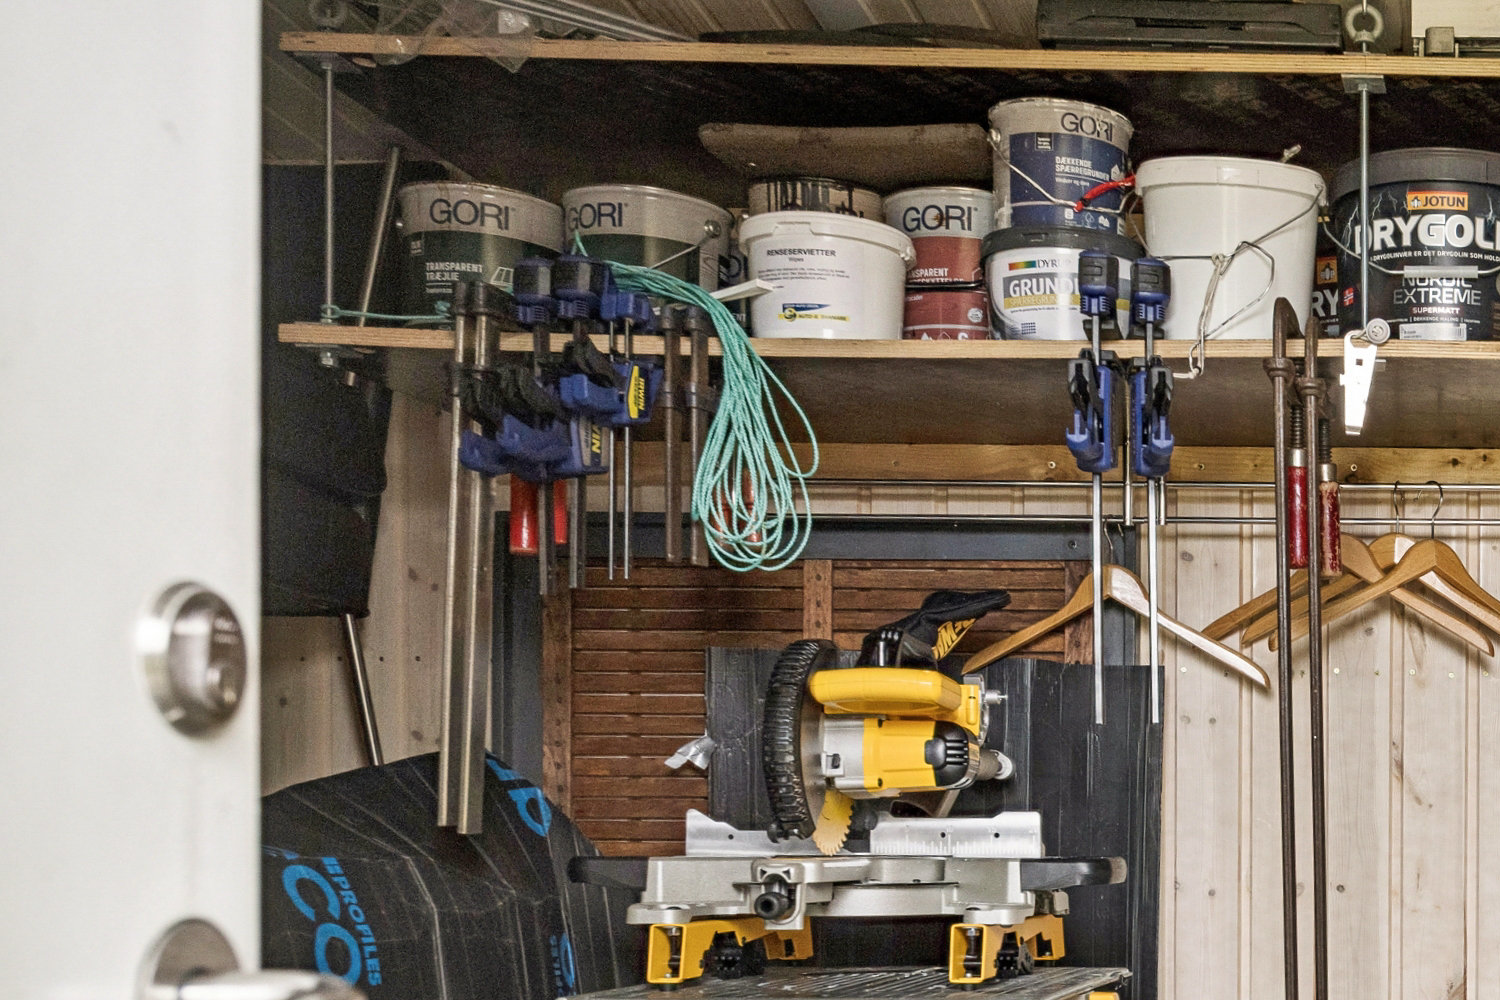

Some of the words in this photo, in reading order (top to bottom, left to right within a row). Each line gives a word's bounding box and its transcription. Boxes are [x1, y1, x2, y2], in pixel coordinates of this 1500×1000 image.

[1061, 112, 1113, 142] GORI
[1422, 195, 1466, 208] JOTUN
[429, 198, 510, 231] GORI
[567, 202, 623, 232] GORI
[903, 205, 973, 232] GORI
[767, 248, 837, 256] RENSESERVIETTER
[425, 262, 483, 273] TRANSPARENT
[909, 268, 949, 278] NSPARENT
[1009, 276, 1080, 298] GRUND
[1393, 288, 1482, 305] EXTREME
[1412, 306, 1461, 314] SUPERMATT
[332, 876, 382, 986] PROFILES
